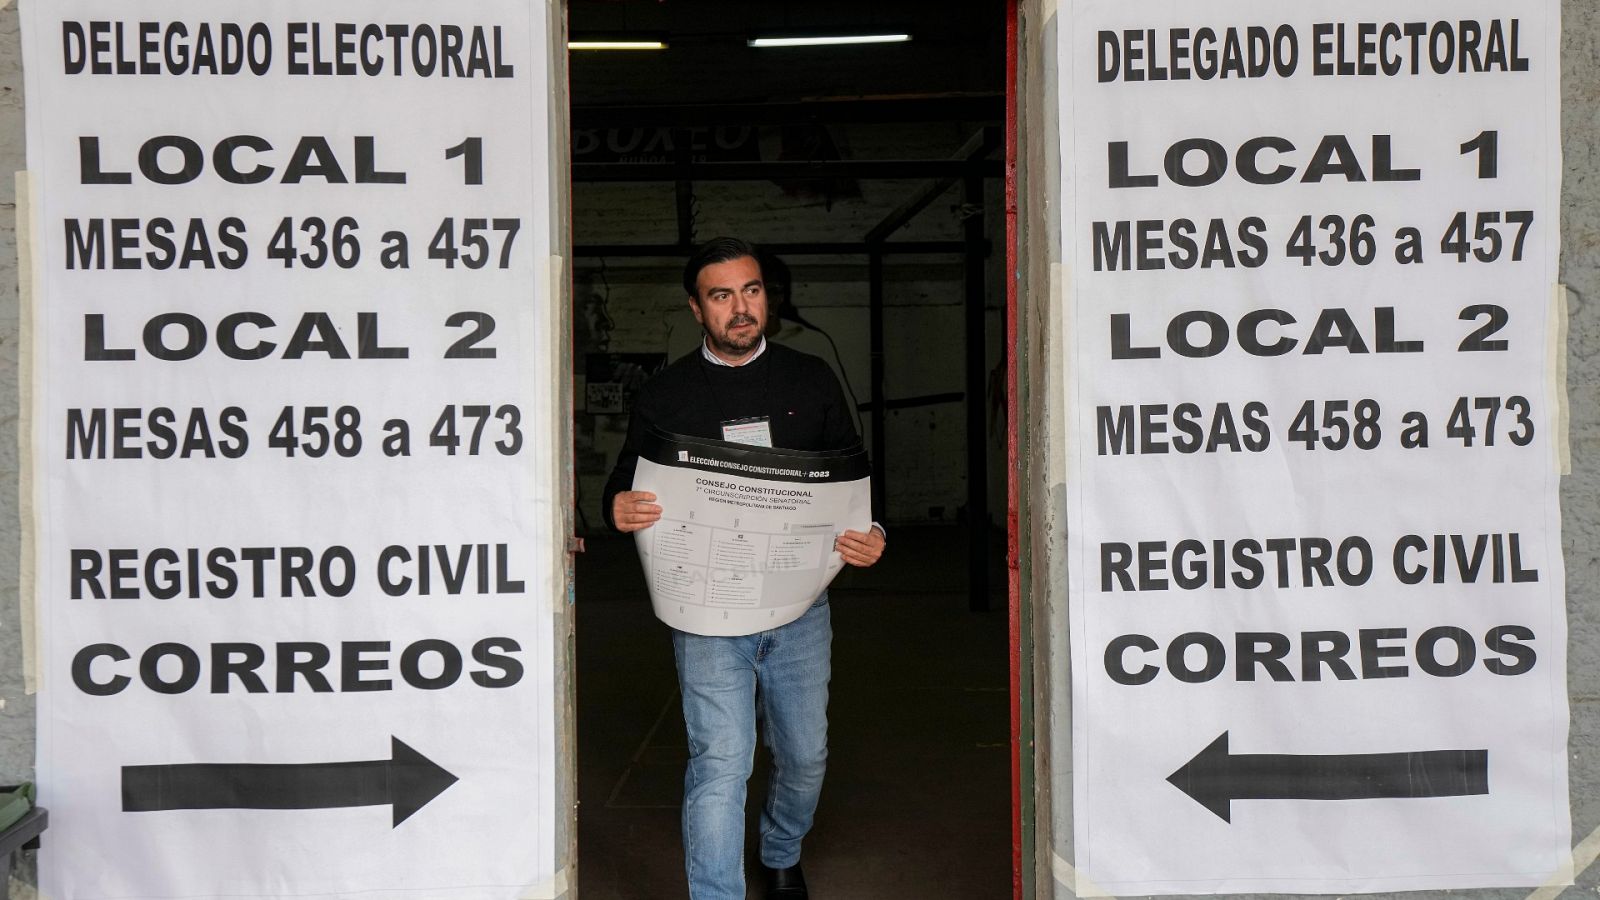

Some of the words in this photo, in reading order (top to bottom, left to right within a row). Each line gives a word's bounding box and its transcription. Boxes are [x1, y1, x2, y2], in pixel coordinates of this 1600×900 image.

[63, 21, 271, 76] DELEGADO
[288, 23, 513, 78] ELECTORAL
[1098, 24, 1298, 83] DELEGADO
[1313, 19, 1528, 76] ELECTORAL
[79, 135, 406, 185] LOCAL
[446, 138, 482, 185] 1
[1108, 135, 1420, 188] LOCAL
[1461, 131, 1498, 179] 1
[65, 217, 248, 270] MESAS
[268, 217, 360, 269] 436
[381, 231, 409, 269] a
[429, 218, 521, 269] 457
[1093, 217, 1267, 271] MESAS
[1287, 214, 1376, 267] 436
[1395, 227, 1423, 264] a
[1441, 211, 1534, 262] 457
[85, 312, 408, 361] LOCAL
[444, 312, 496, 359] 2
[1111, 307, 1424, 360] LOCAL
[1458, 304, 1508, 351] 2
[67, 407, 248, 459] MESAS
[269, 406, 362, 457] 458
[383, 419, 410, 457] a
[430, 405, 522, 456] 473
[1097, 402, 1270, 456] MESAS
[1289, 399, 1381, 451] 458
[1401, 412, 1429, 449] a
[1447, 396, 1534, 447] 473
[690, 456, 719, 467] ELECCIÓN
[720, 461, 748, 472] CONSEJO
[749, 465, 803, 477] CONSTITUCIONAL
[808, 470, 830, 478] 2023
[696, 477, 736, 490] CONSEJO
[738, 485, 813, 498] CONSTITUCIONAL
[71, 546, 355, 600] REGISTRO
[378, 544, 525, 596] CIVIL
[1101, 536, 1373, 592] REGISTRO
[1393, 533, 1538, 584] CIVIL
[72, 638, 523, 696] CORREOS
[1104, 625, 1536, 685] CORREOS
